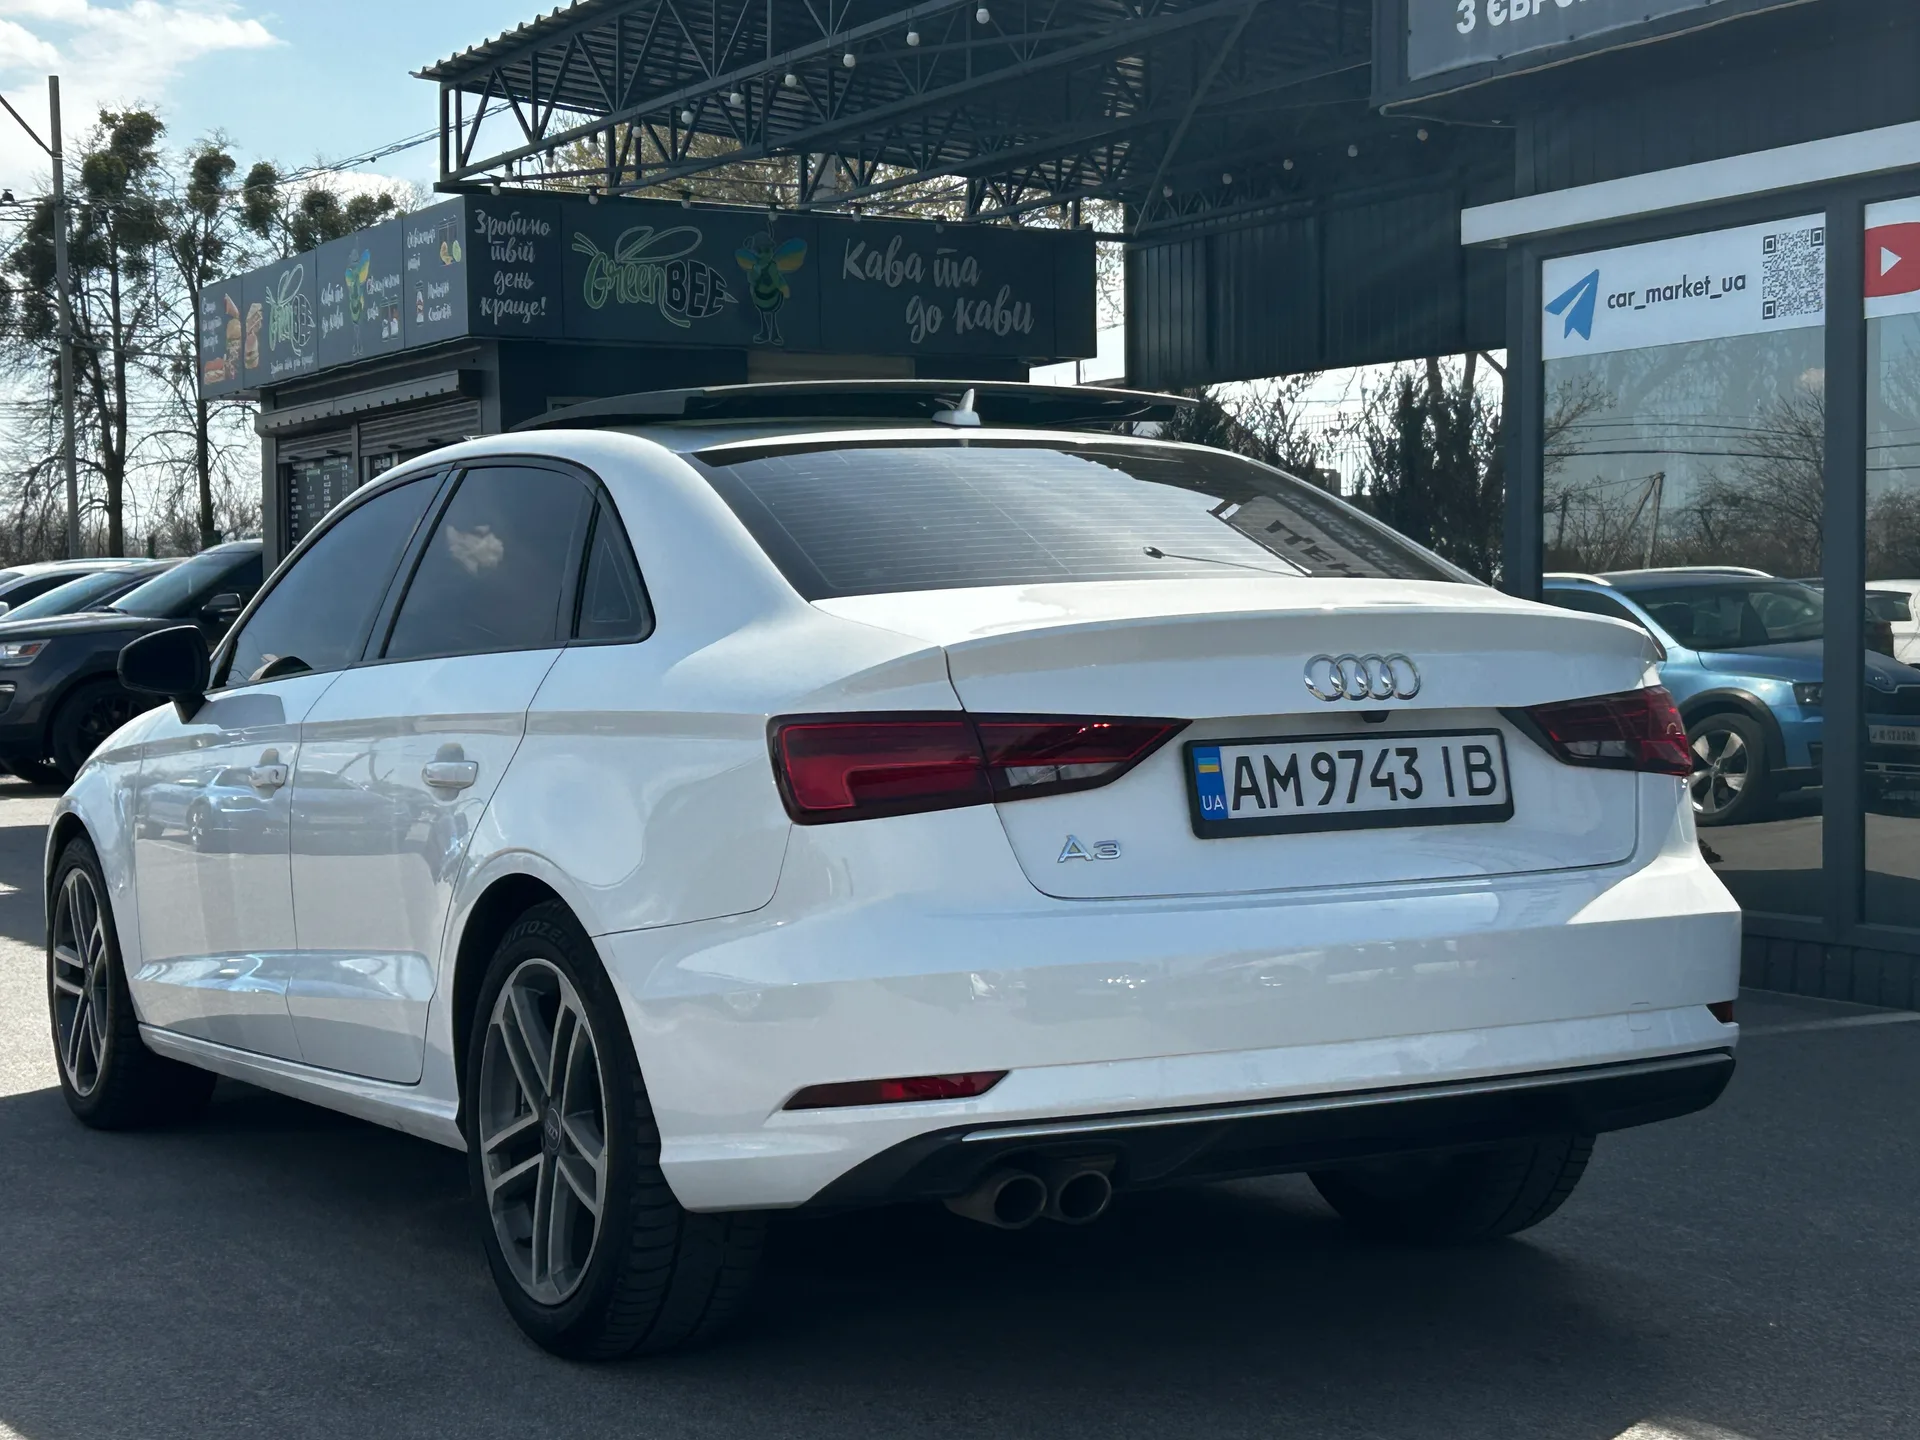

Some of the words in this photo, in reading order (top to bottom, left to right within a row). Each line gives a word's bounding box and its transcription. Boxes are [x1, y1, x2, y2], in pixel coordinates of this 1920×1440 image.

[474, 209, 551, 243] Зробимо
[490, 237, 536, 264] твій
[843, 235, 927, 288] Кава
[933, 247, 983, 288] та
[493, 270, 535, 296] день
[1606, 273, 1748, 311] car_market_ua
[479, 296, 547, 326] краще!
[905, 294, 943, 344] до
[952, 284, 1035, 336] кави
[1231, 752, 1305, 812] AM
[1310, 746, 1424, 807] 9743
[1440, 744, 1498, 798] IB
[1202, 795, 1225, 812] UA
[1056, 834, 1121, 863] A3
